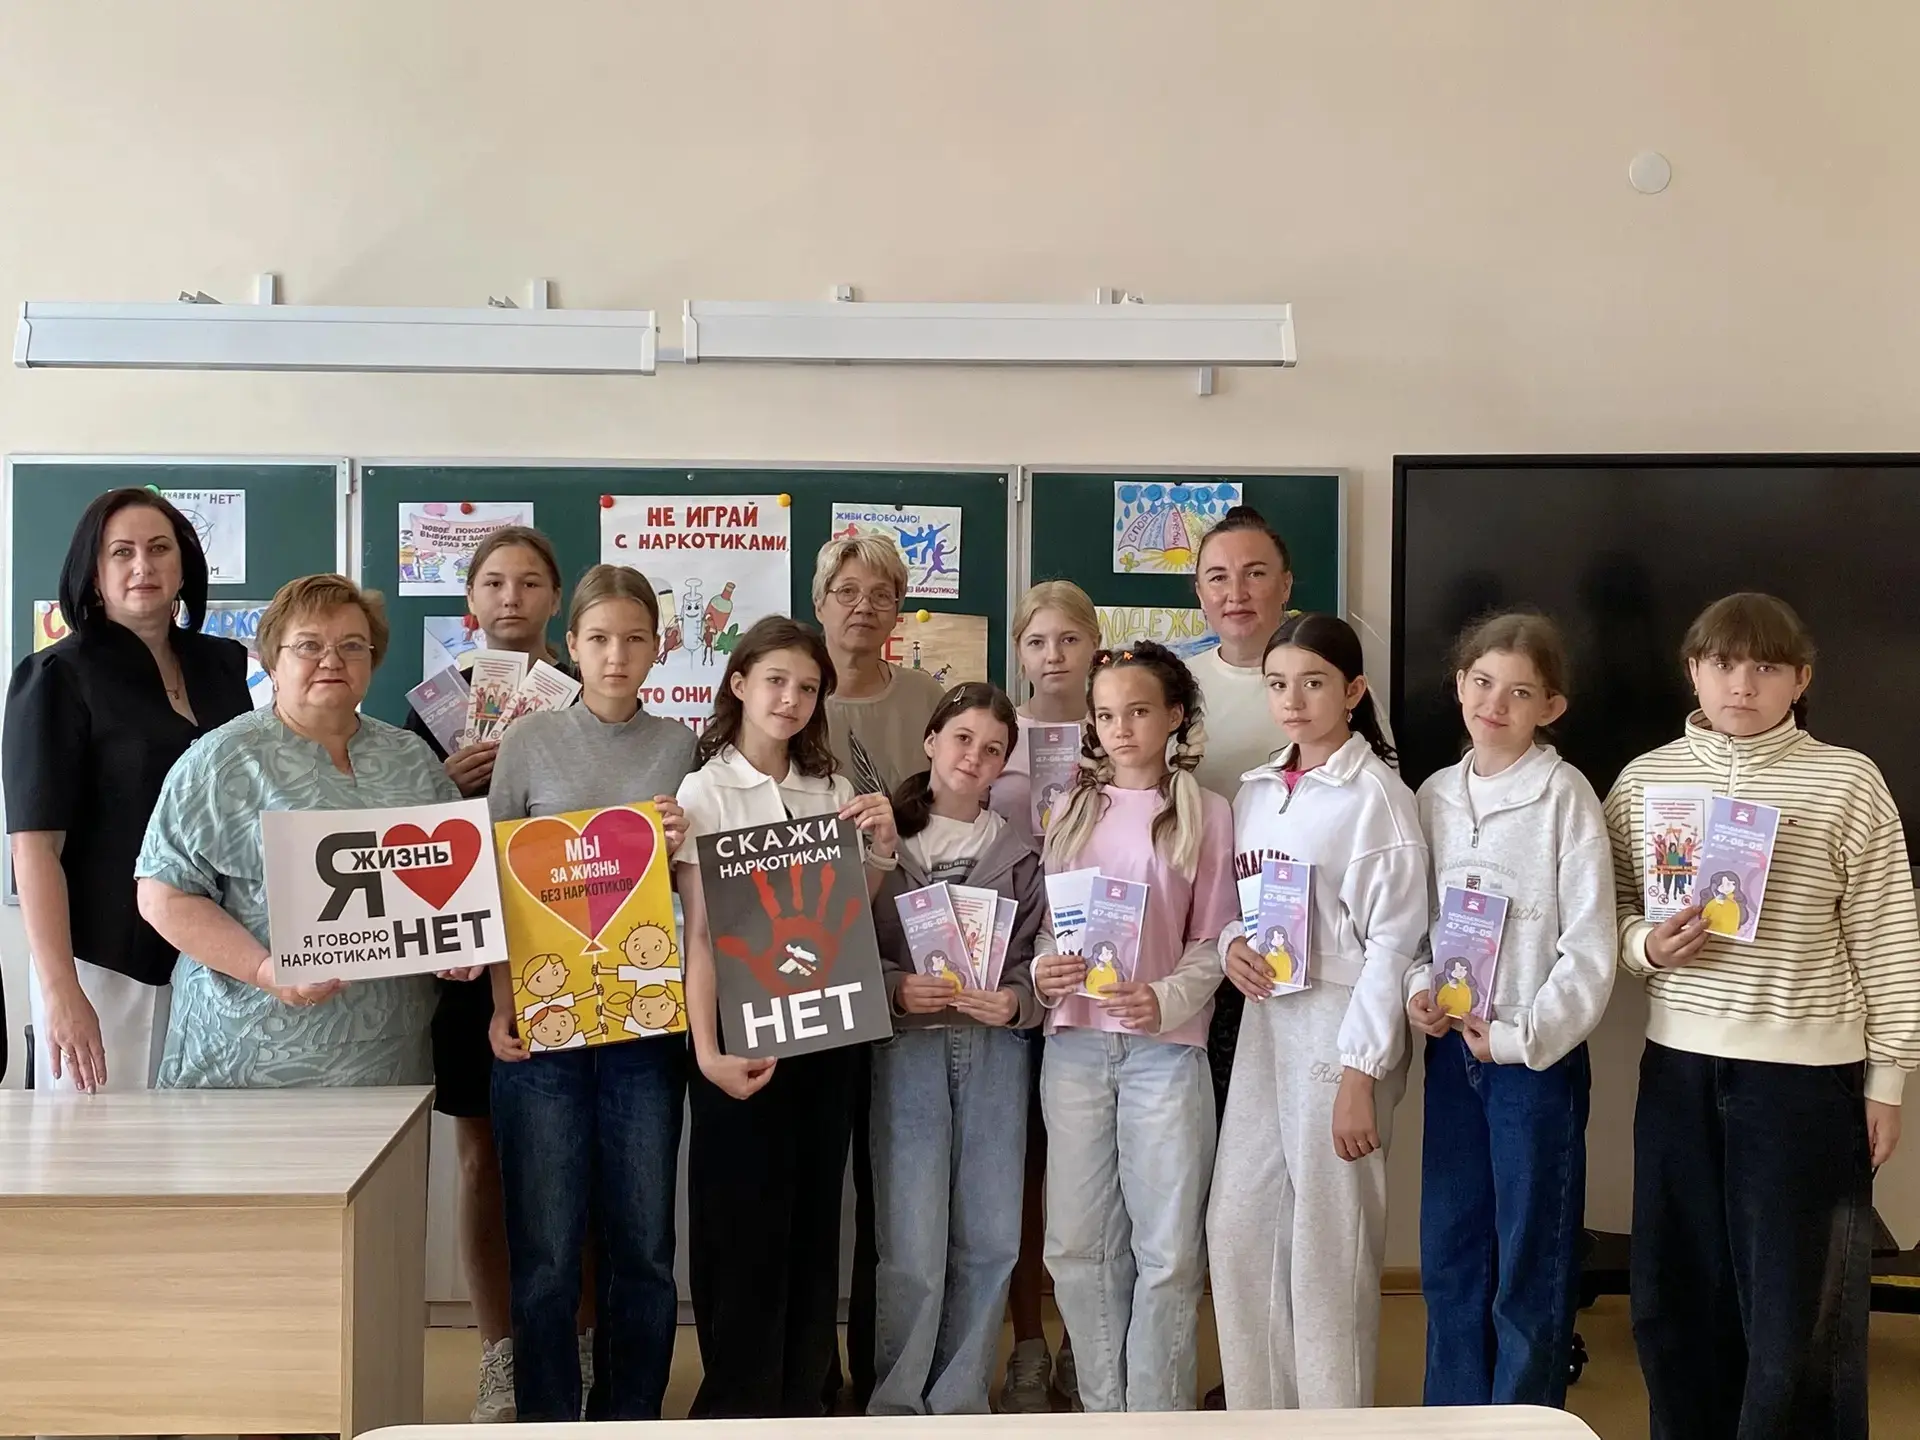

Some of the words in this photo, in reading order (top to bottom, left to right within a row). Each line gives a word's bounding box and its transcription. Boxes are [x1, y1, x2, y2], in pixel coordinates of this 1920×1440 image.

[647, 507, 675, 528] НЕ
[686, 501, 759, 528] ИГРАЙ
[836, 512, 862, 520] ЖИВИ
[863, 512, 920, 524] СВОБОДНО!
[1127, 511, 1153, 543] СПОРТ
[420, 530, 466, 542] ВЫБИРАЕТ
[421, 523, 450, 534] НОВОЕ
[432, 540, 459, 548] ОБРАЗ
[614, 534, 627, 549] С
[638, 532, 790, 553] НАРКОТИКАМИ,
[671, 686, 712, 703] ОНИ
[564, 835, 601, 863] МЫ
[715, 818, 839, 858] СКАЖИ
[550, 867, 567, 884] ЗА
[570, 859, 620, 881] ЖИЗНЬ!
[719, 845, 842, 879] НАРКОТИКАМ
[315, 831, 386, 922] Я
[351, 845, 449, 871] ЖИЗНЬ
[540, 887, 561, 903] БЕЗ
[563, 877, 633, 900] НАРКОТИКОВ
[303, 935, 313, 949] Я
[318, 929, 389, 947] ГОВОРЮ
[392, 909, 492, 959] НЕТ
[280, 946, 391, 967] НАРКОТИКАМ
[741, 981, 862, 1050] НЕТ
